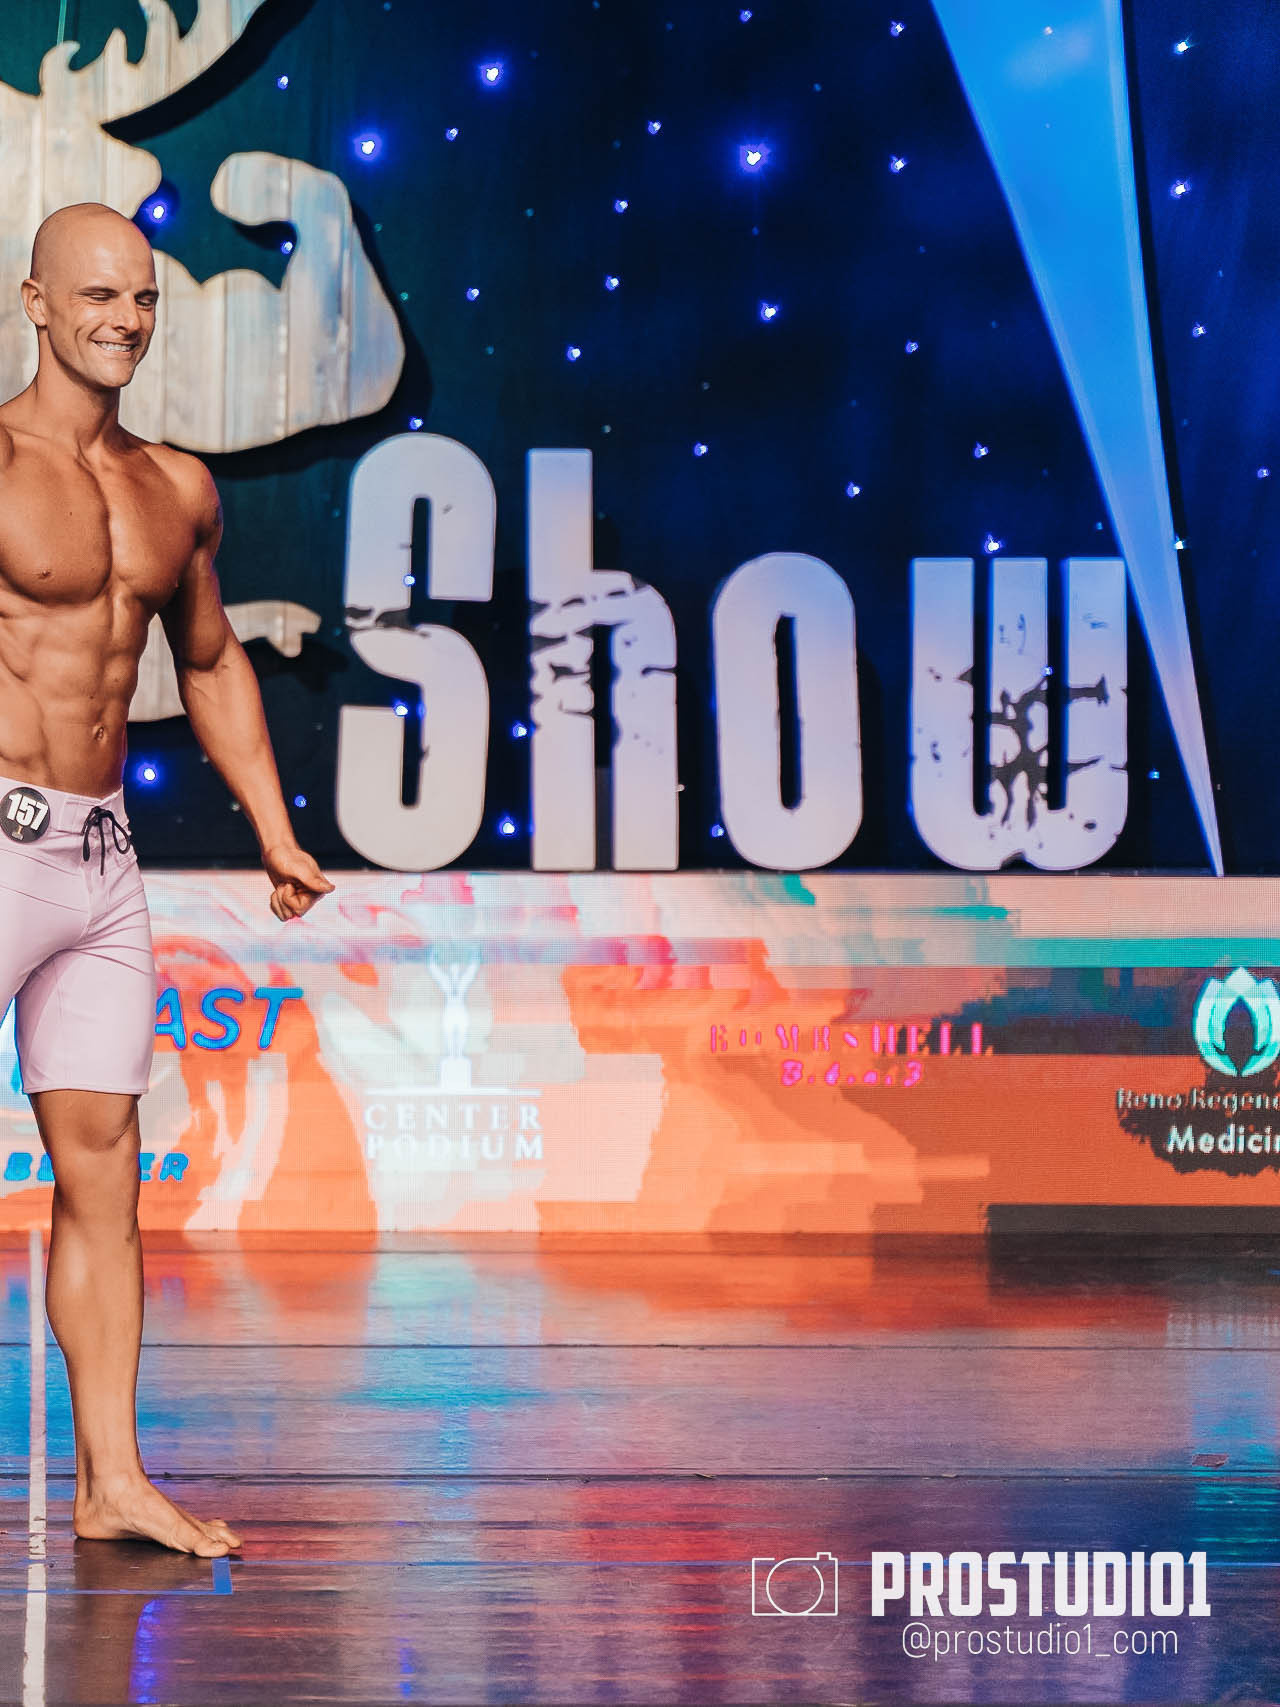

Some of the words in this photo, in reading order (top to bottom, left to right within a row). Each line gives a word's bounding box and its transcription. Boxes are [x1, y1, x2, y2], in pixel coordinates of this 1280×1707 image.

[336, 433, 1129, 871] Show
[7, 793, 48, 831] 157
[365, 1104, 542, 1130] CENTER
[366, 1134, 543, 1161] PODIUM
